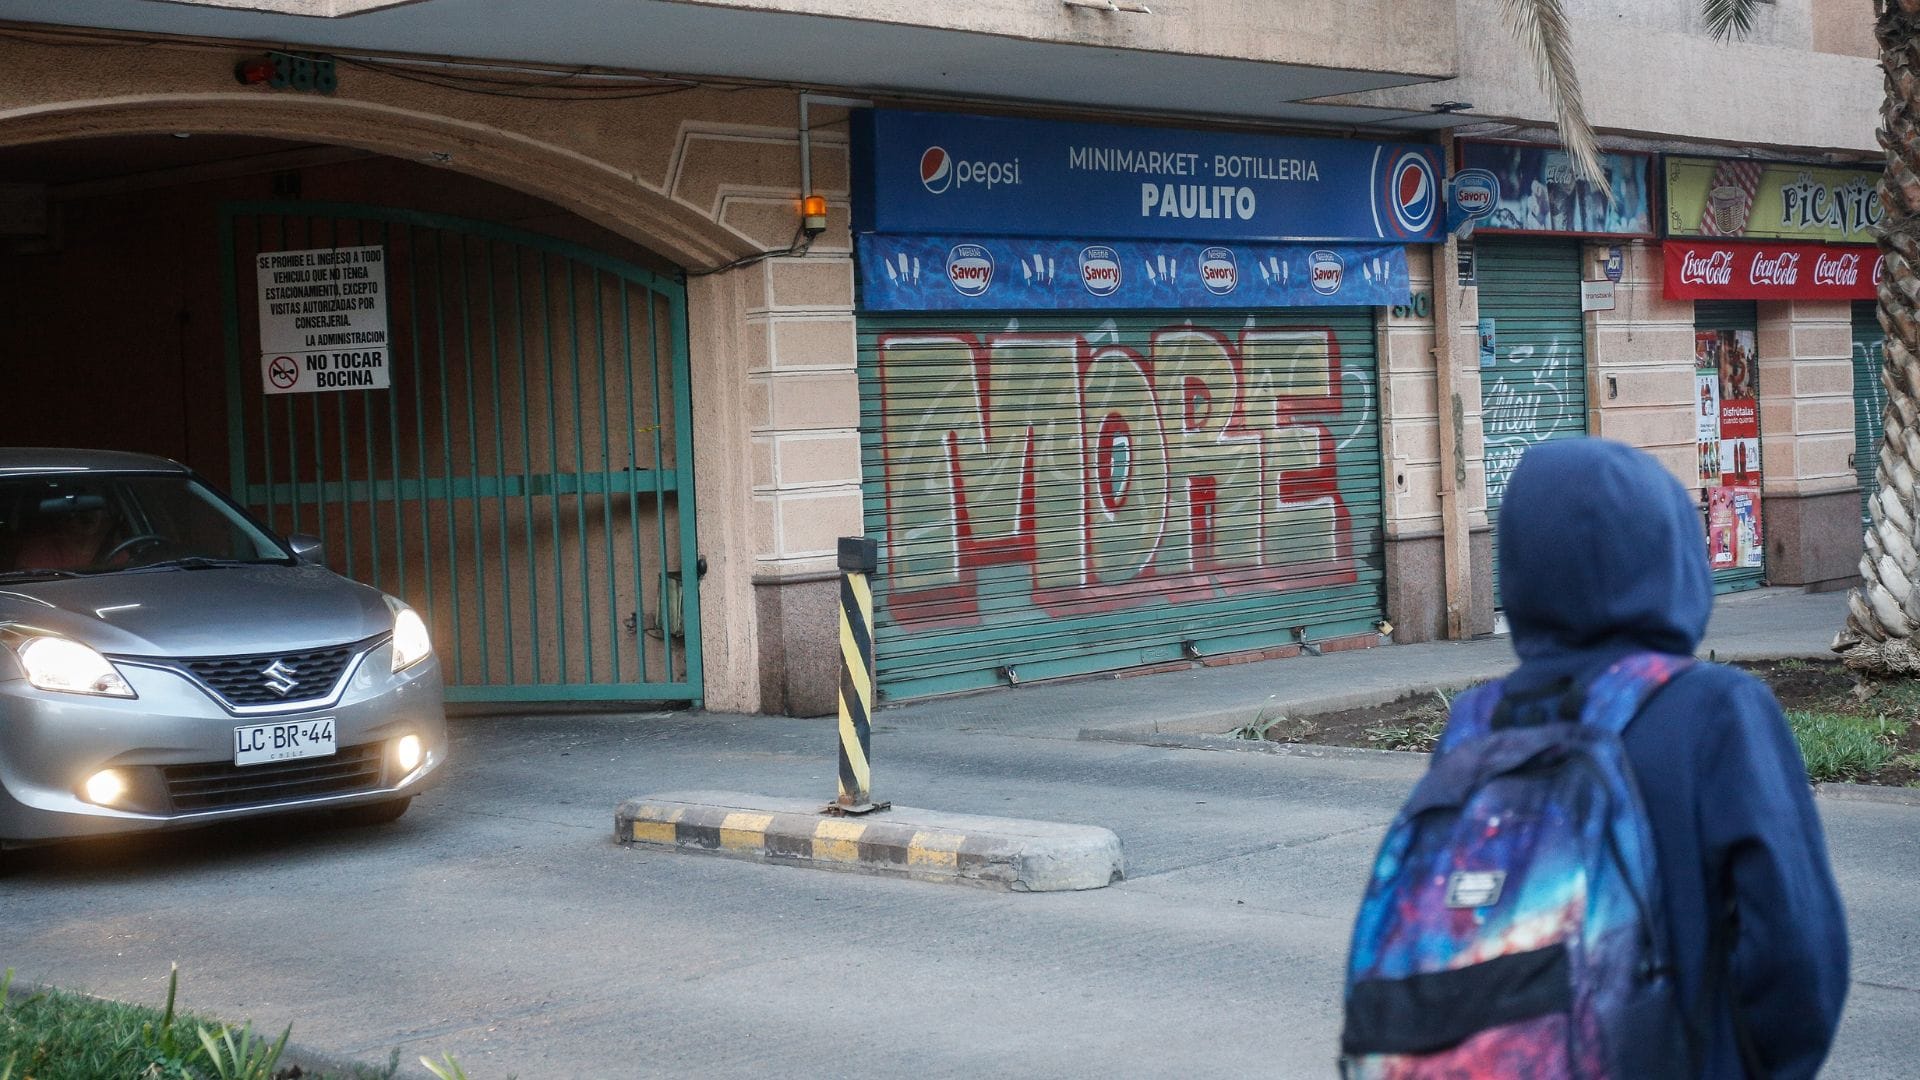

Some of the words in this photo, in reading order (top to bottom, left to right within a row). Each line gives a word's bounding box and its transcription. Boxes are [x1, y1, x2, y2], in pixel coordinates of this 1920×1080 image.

[1069, 146, 1199, 176] MINIMARKET
[1215, 155, 1319, 182] BOTILLERIA
[957, 157, 1020, 190] pepsi
[1142, 183, 1256, 220] PAULITO
[1459, 191, 1489, 203] Savory
[260, 256, 270, 269] SE
[271, 254, 304, 268] PROHIBE
[306, 253, 316, 266] EL
[317, 252, 350, 266] INGRESO
[353, 251, 359, 263] A
[362, 250, 382, 262] TODO
[273, 269, 310, 284] VEHICULO
[312, 268, 327, 282] QUE
[330, 268, 340, 281] NO
[343, 266, 368, 280] TENGA
[950, 264, 990, 282] Savory
[1084, 265, 1118, 283] Savory
[1203, 266, 1234, 282] Savory
[1314, 268, 1341, 282] Savory
[266, 284, 342, 300] ESTACIONAMIENTO,
[343, 282, 378, 296] EXCEPTO
[270, 302, 300, 315] VISITAS
[302, 298, 357, 314] AUTORIZADAS
[358, 297, 374, 310] POR
[295, 314, 352, 329] CONSERJERIA.
[306, 334, 316, 346] LA
[318, 330, 385, 346] ADMINISTRACION
[306, 354, 328, 370] NO
[332, 352, 382, 369] TOCAR
[316, 369, 374, 388] BOCINA
